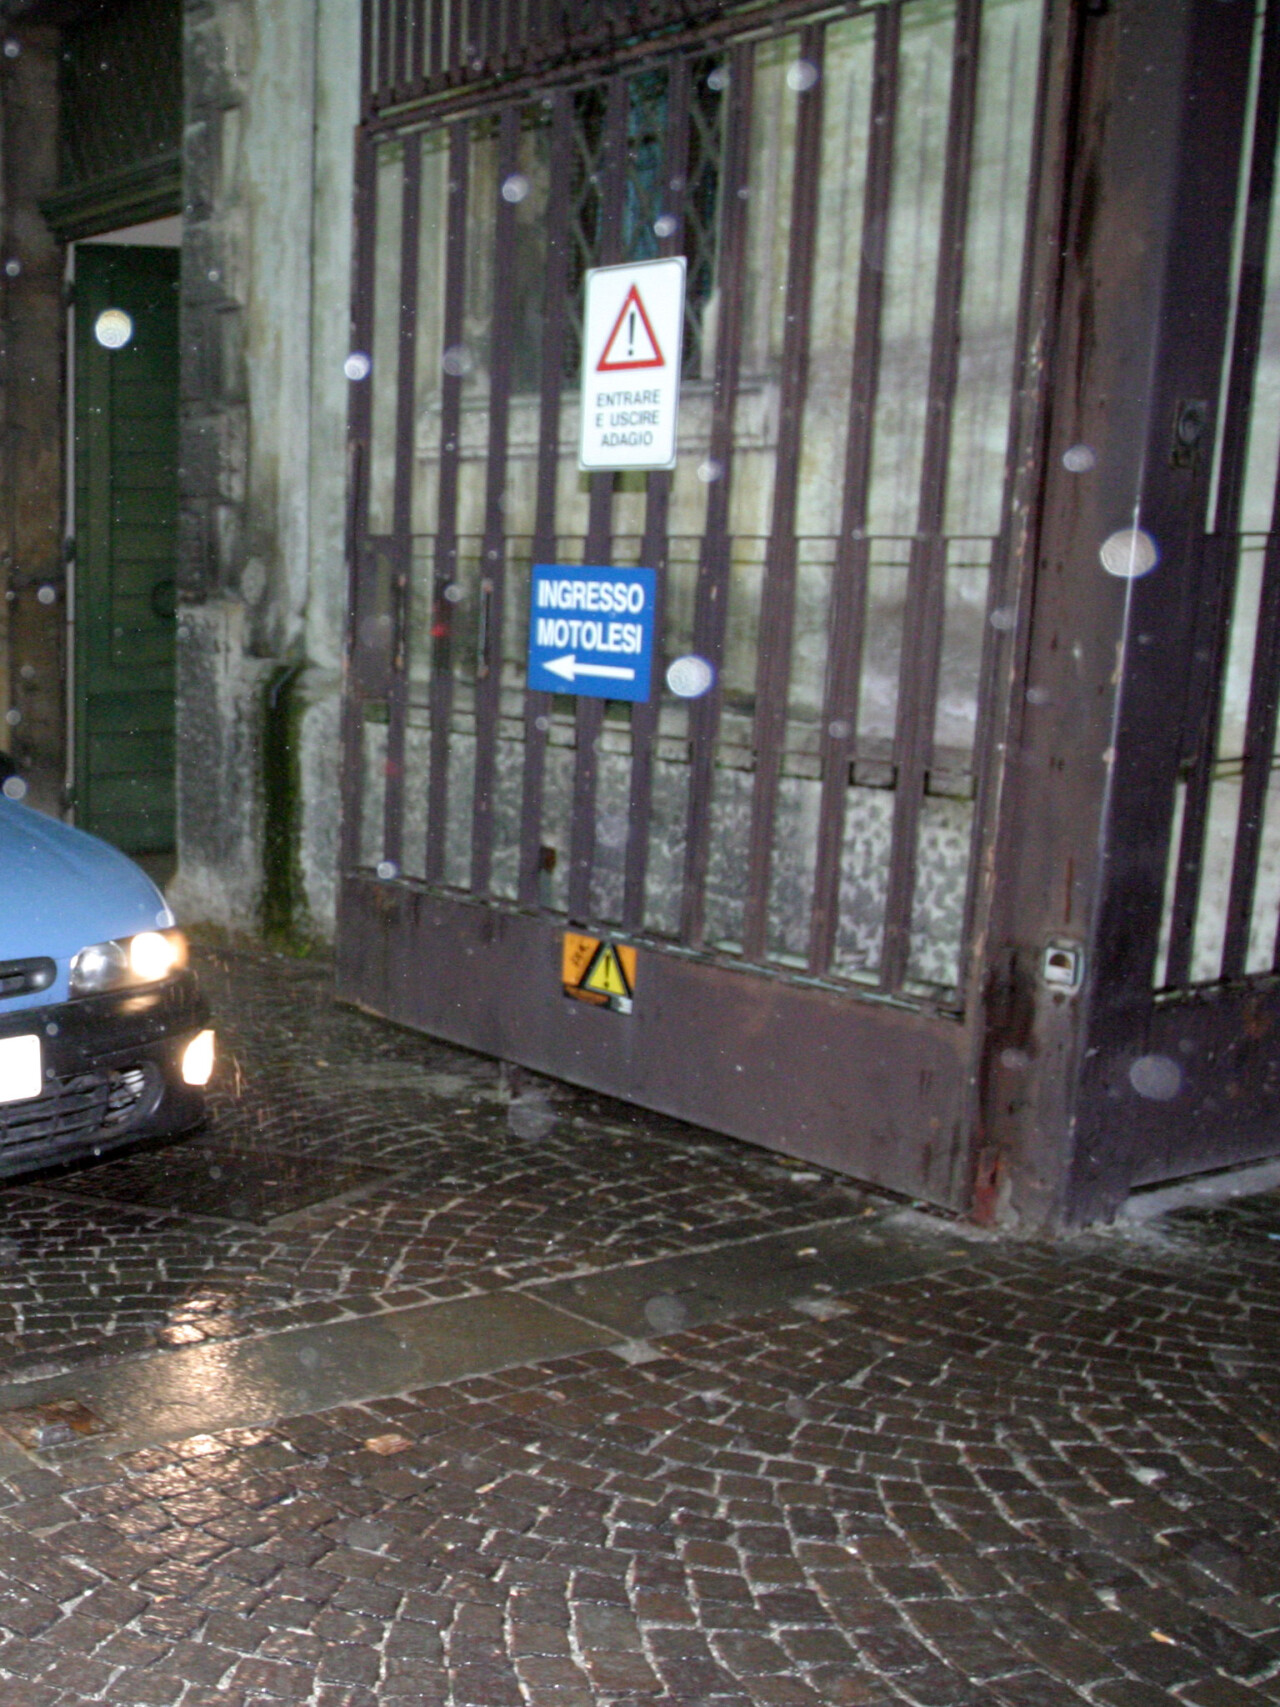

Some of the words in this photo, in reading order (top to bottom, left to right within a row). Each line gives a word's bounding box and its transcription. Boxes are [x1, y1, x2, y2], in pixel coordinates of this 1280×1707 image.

[596, 388, 661, 408] ENTRARE
[595, 412, 605, 428] E
[610, 409, 661, 427] USCIRE
[600, 430, 654, 447] ADAGIO
[537, 579, 645, 614] INGRESSO
[536, 618, 643, 655] MOTOLESI
